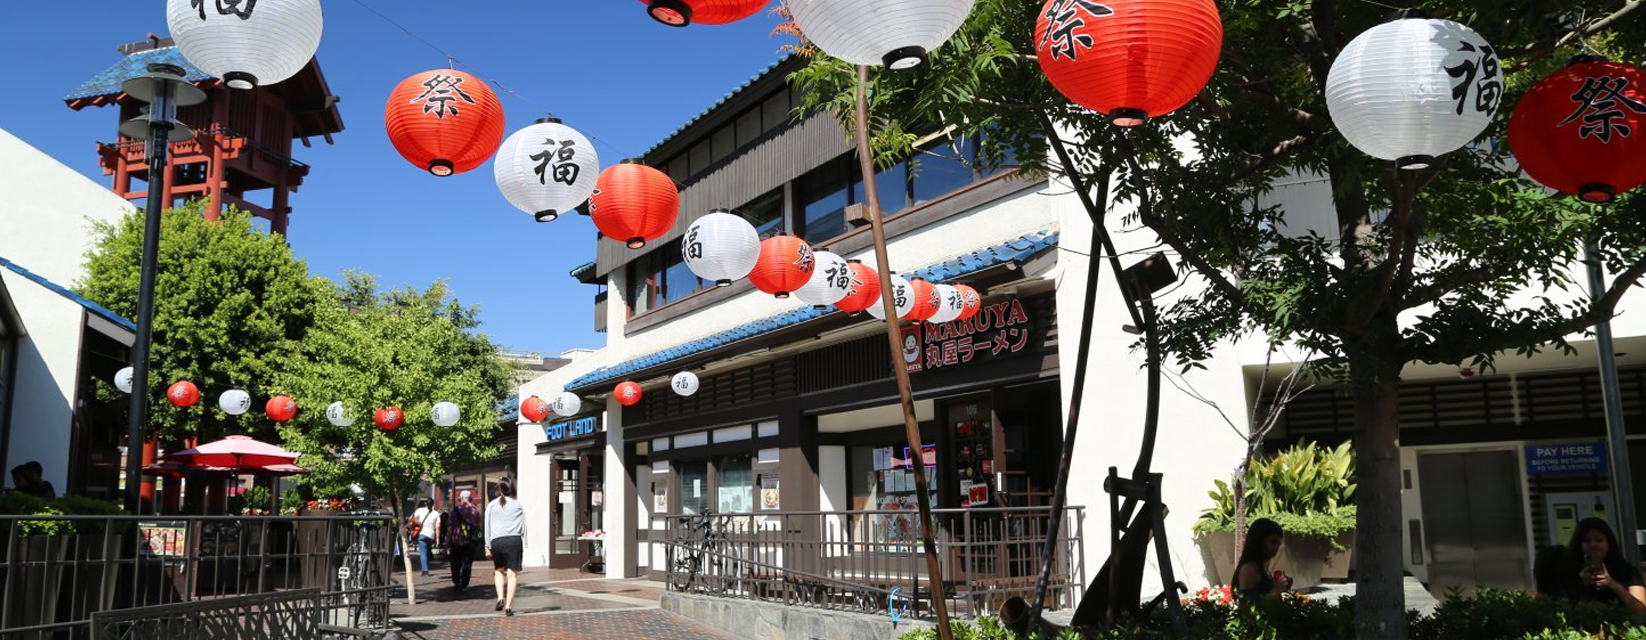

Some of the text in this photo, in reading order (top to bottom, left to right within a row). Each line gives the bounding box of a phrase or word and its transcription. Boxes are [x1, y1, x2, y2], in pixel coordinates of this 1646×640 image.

[1038, 0, 1115, 61] 祭
[410, 74, 476, 119] 祭
[1443, 40, 1501, 118] 福
[1555, 75, 1646, 143] 祭
[529, 137, 581, 187] 福
[682, 225, 702, 263] 福
[792, 244, 814, 273] 祭
[825, 260, 850, 290] 福
[948, 290, 964, 311] 福
[924, 299, 1028, 344] MARUYA
[926, 328, 1028, 369] 丸屋ラーメン
[546, 417, 593, 440] FOOT LAND
[1536, 445, 1593, 457] PAY HERE
